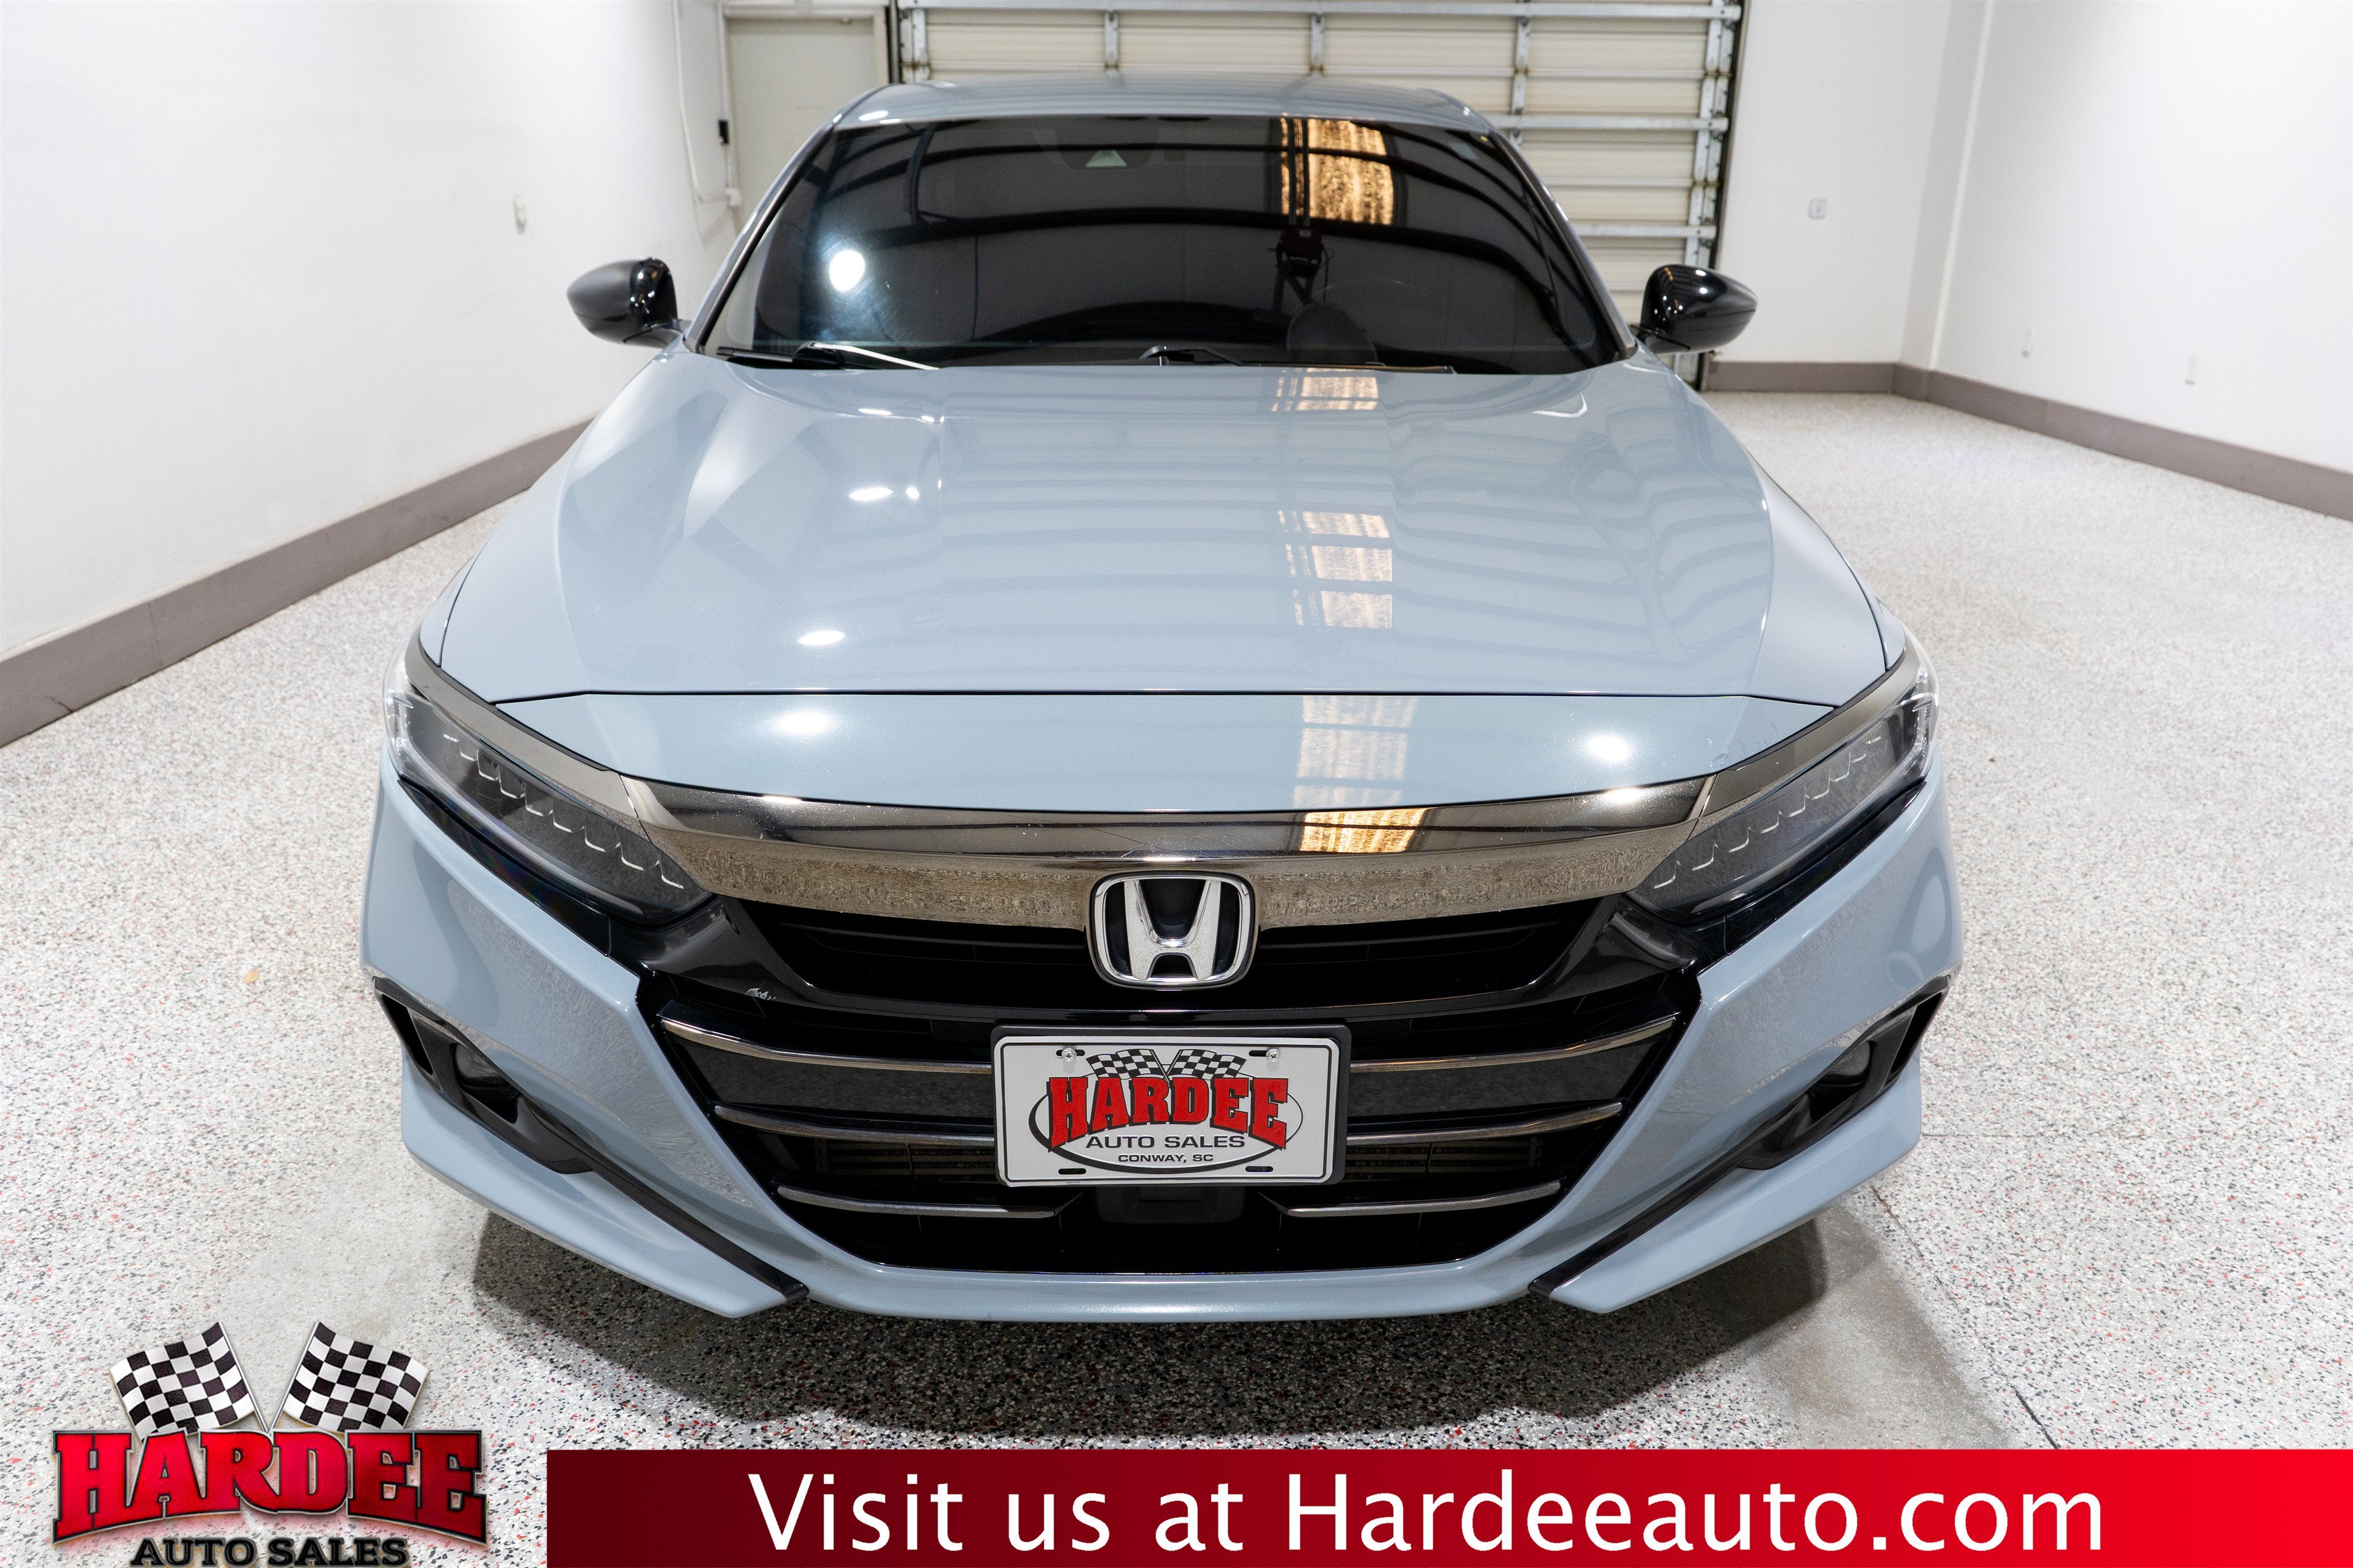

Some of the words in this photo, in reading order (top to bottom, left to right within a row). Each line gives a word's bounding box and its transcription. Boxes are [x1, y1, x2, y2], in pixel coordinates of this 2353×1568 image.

[1047, 1077, 1289, 1149] HARDEE
[1085, 1136, 1155, 1148] AUTO
[1164, 1136, 1245, 1148] SALES
[1118, 1154, 1187, 1163] CONWAY,
